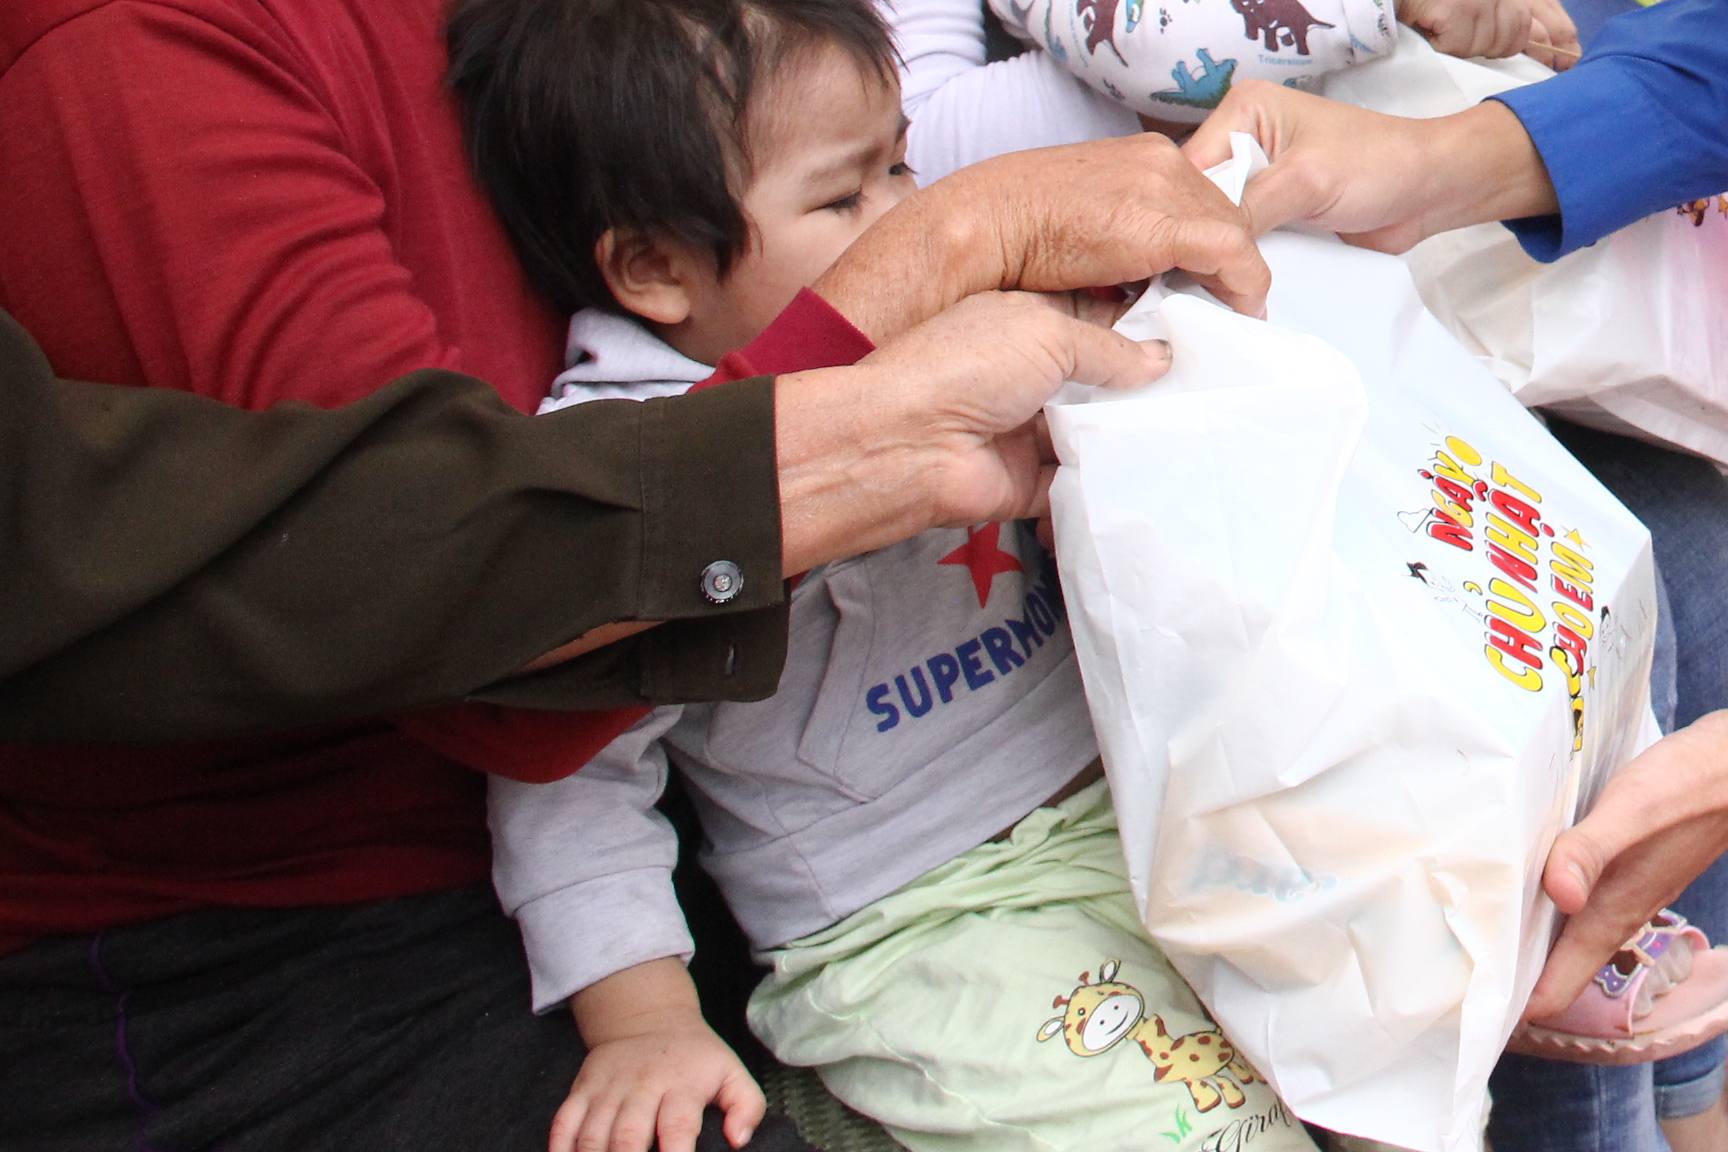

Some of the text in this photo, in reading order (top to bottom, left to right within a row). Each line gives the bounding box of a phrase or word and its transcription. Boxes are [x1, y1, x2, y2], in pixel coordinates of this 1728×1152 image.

[1463, 461, 1555, 693] CHỦ NHẬT
[1549, 541, 1595, 612] EM
